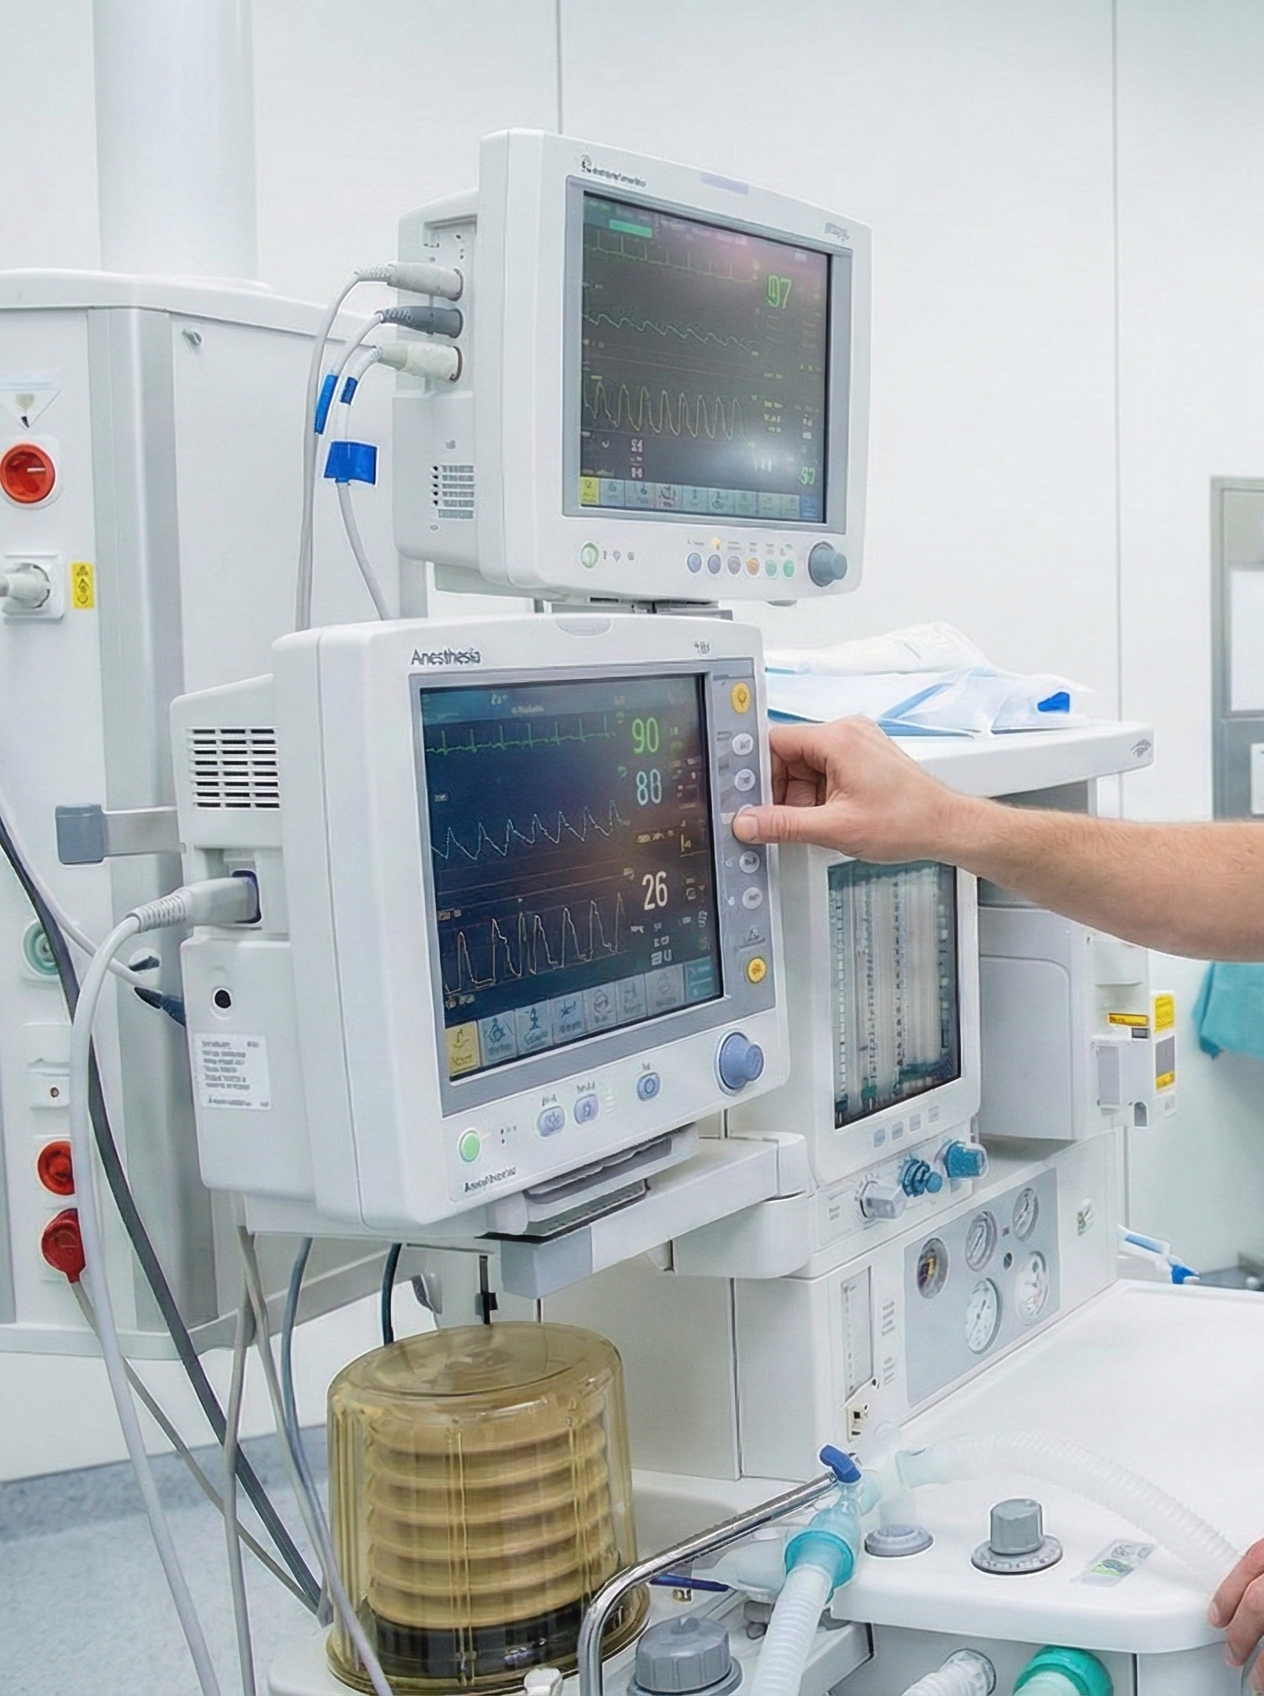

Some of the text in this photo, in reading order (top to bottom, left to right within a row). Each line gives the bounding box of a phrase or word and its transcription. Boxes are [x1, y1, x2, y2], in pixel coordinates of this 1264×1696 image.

[766, 274, 793, 309] 97
[632, 717, 659, 754] 90
[642, 871, 668, 911] 26
